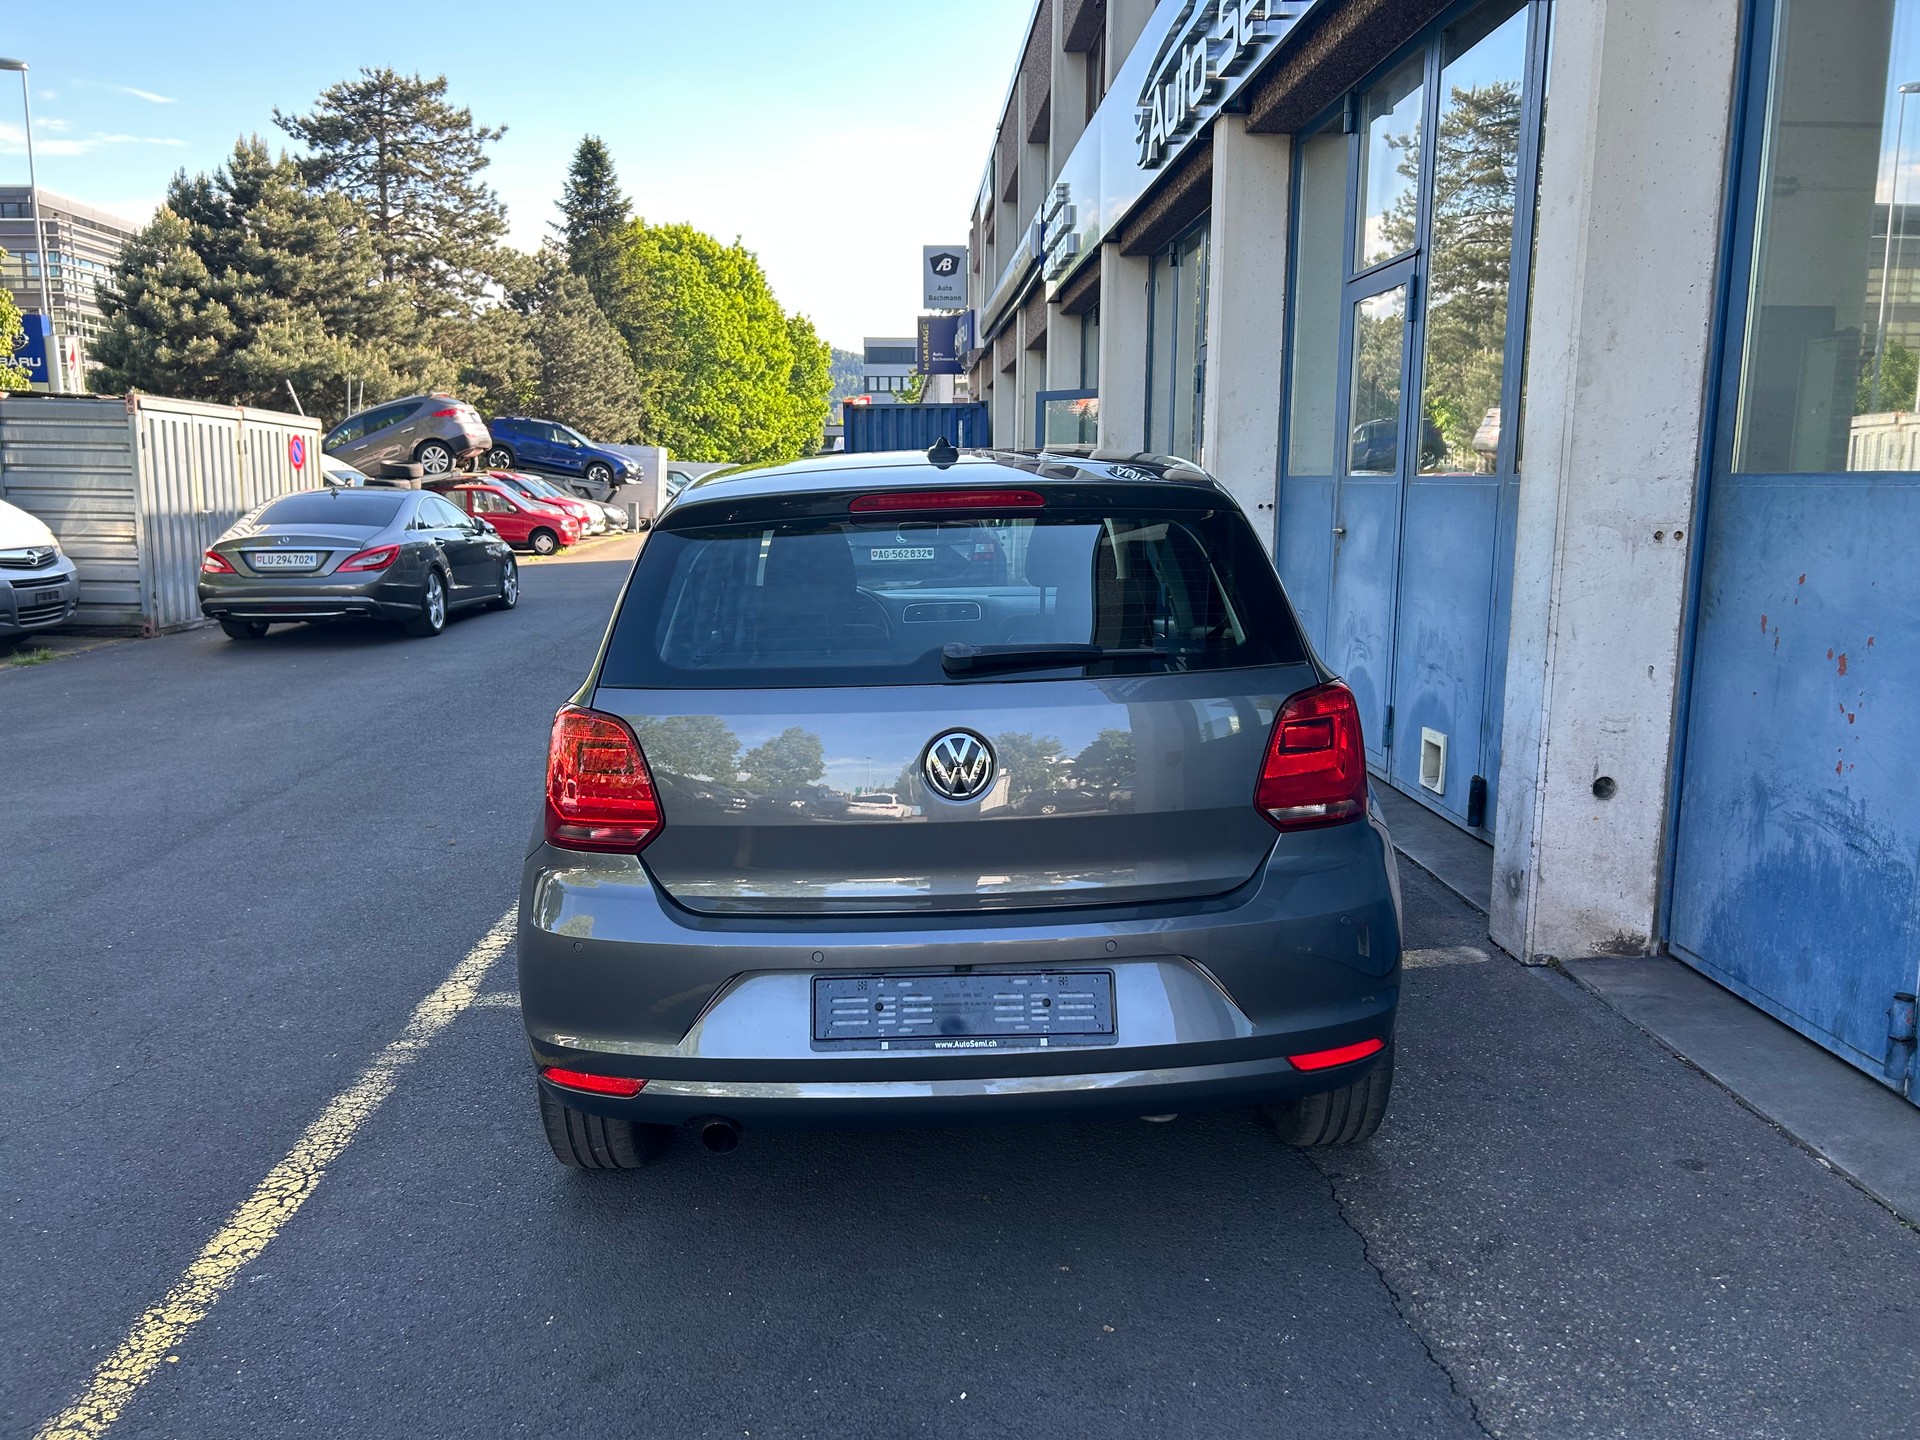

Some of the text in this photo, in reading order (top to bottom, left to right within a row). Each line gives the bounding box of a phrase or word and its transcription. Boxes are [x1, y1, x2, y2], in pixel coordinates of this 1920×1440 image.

[1147, 0, 1272, 163] Auto Se
[934, 1039, 998, 1049] www.AutoSemi.ch
